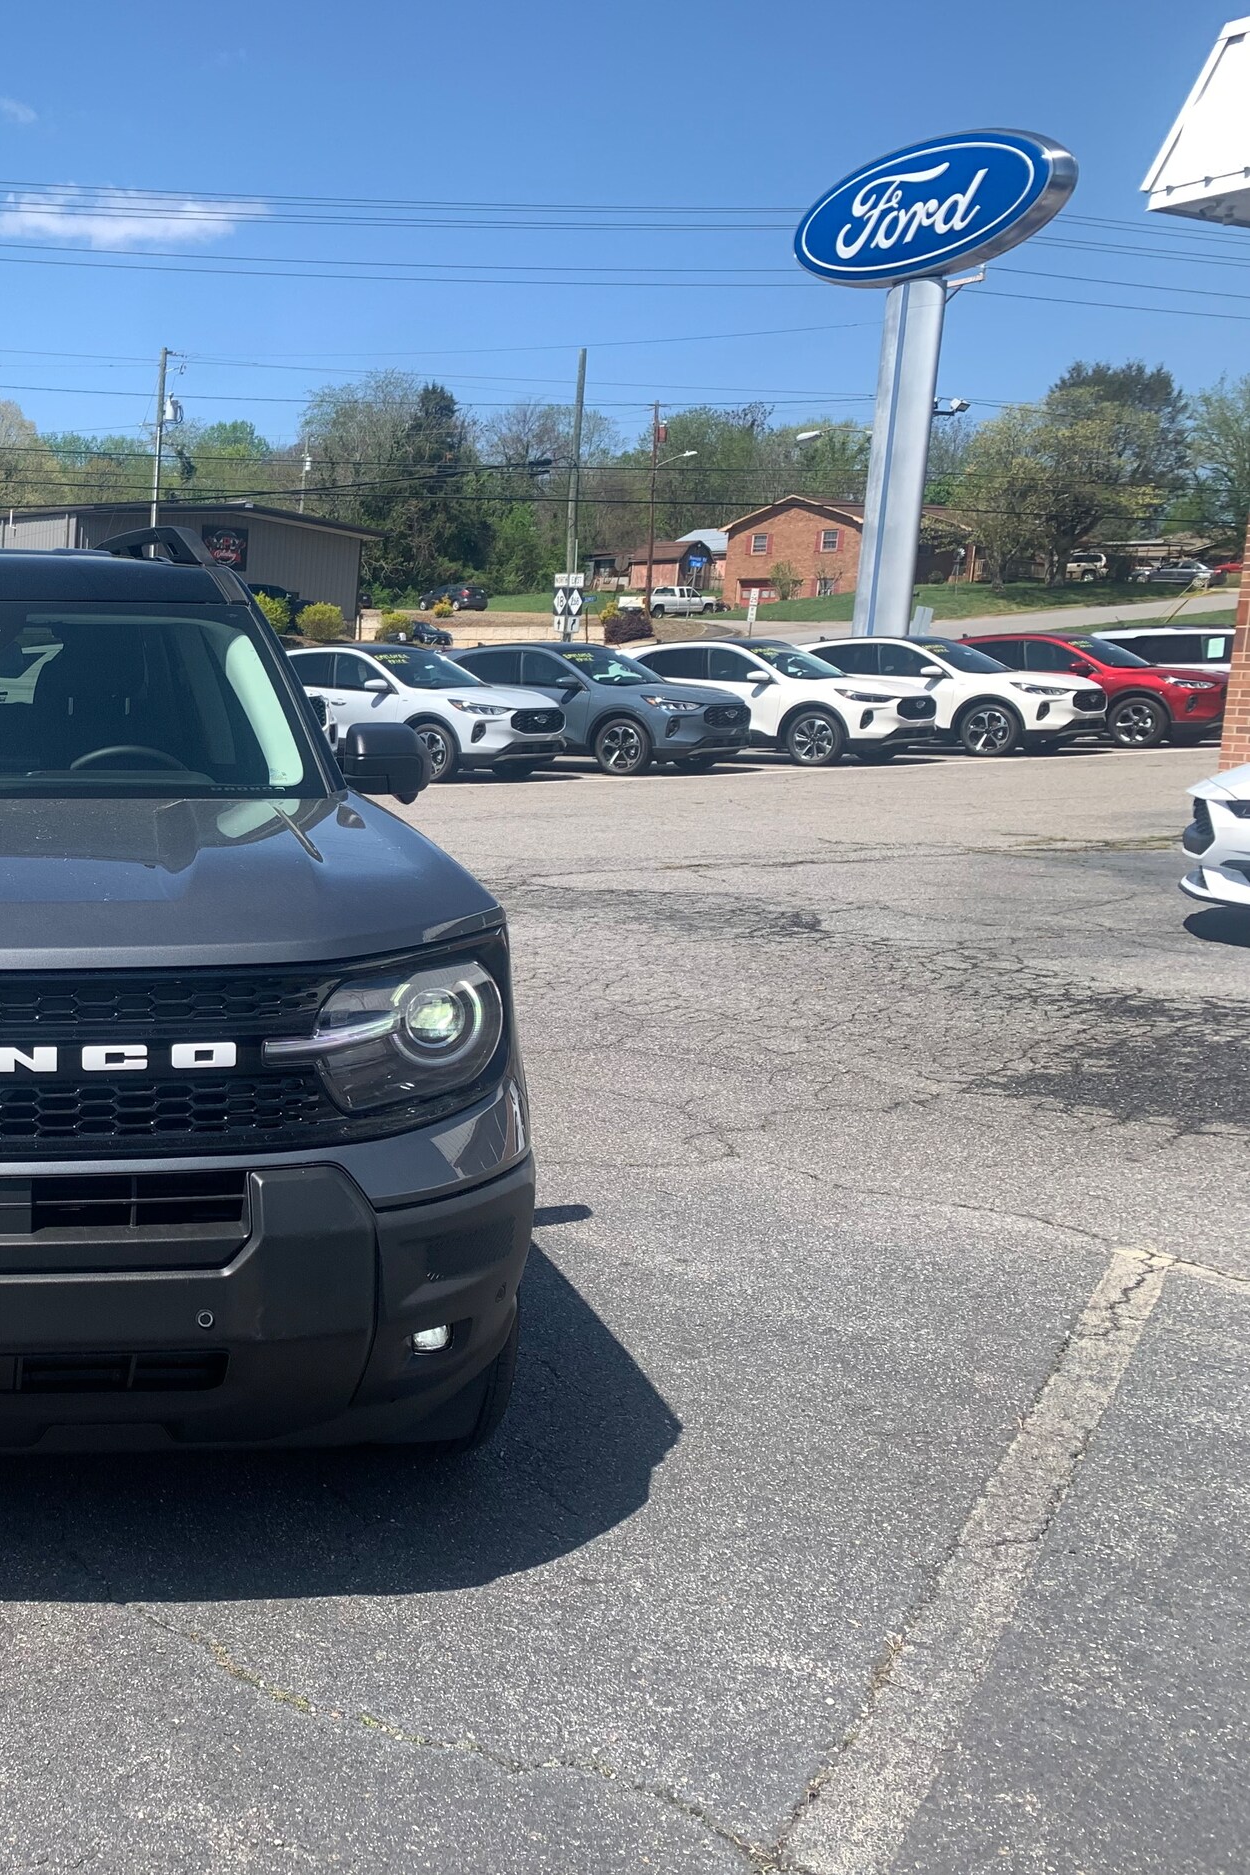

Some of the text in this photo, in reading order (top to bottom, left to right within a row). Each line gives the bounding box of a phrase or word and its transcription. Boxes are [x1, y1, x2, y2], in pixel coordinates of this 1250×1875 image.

[835, 161, 989, 260] Ford
[555, 575, 568, 584] NORTH
[571, 575, 582, 585] EAST
[557, 595, 564, 608] 18
